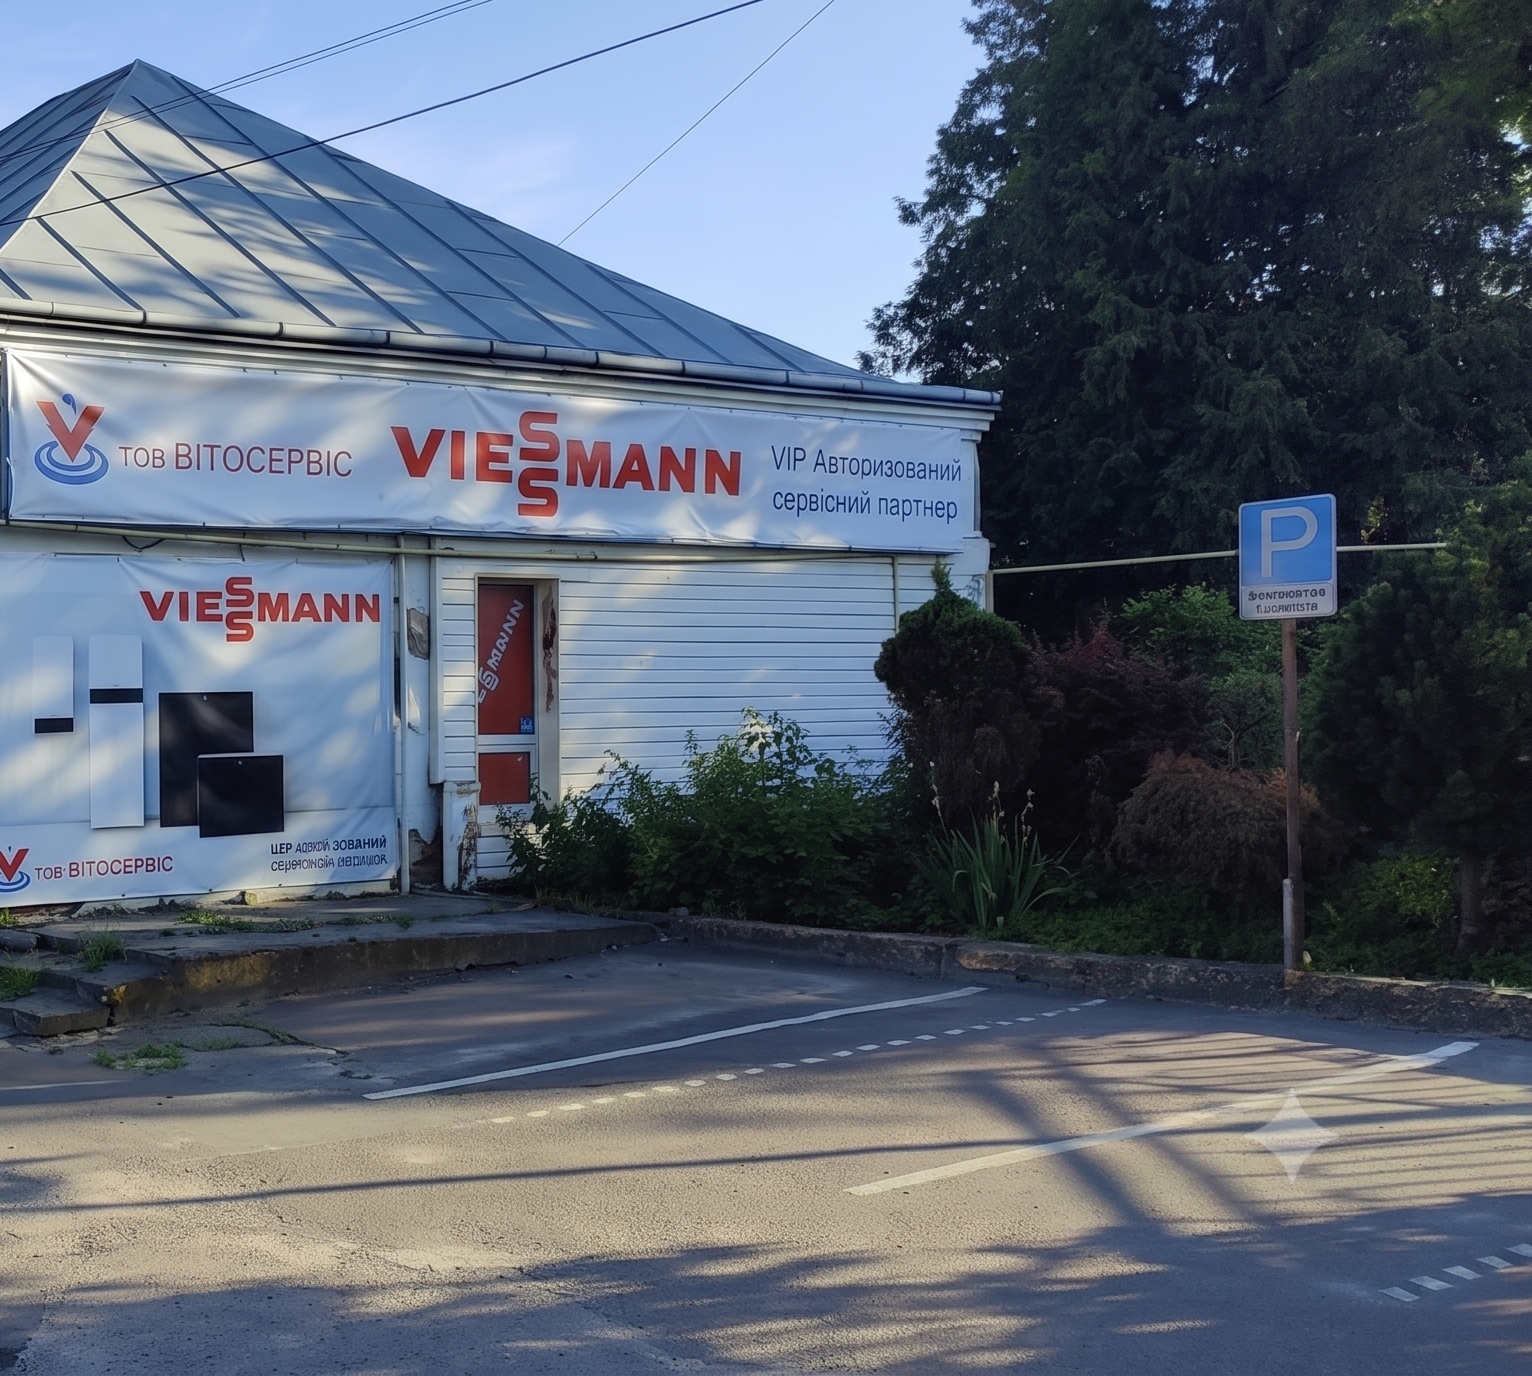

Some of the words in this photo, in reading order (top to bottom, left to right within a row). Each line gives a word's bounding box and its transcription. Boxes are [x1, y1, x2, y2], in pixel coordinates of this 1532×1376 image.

[118, 445, 166, 470] ТОВ
[174, 441, 354, 478] ВІТОСЕРВІС
[389, 410, 742, 518] VIESSMANN
[771, 444, 807, 474] VIP
[813, 448, 963, 482] Авторизований
[772, 488, 871, 518] сервісний
[877, 496, 959, 524] партнер
[139, 576, 380, 643] VIESSMANN
[68, 856, 174, 878] ВІТОСЕРВІС
